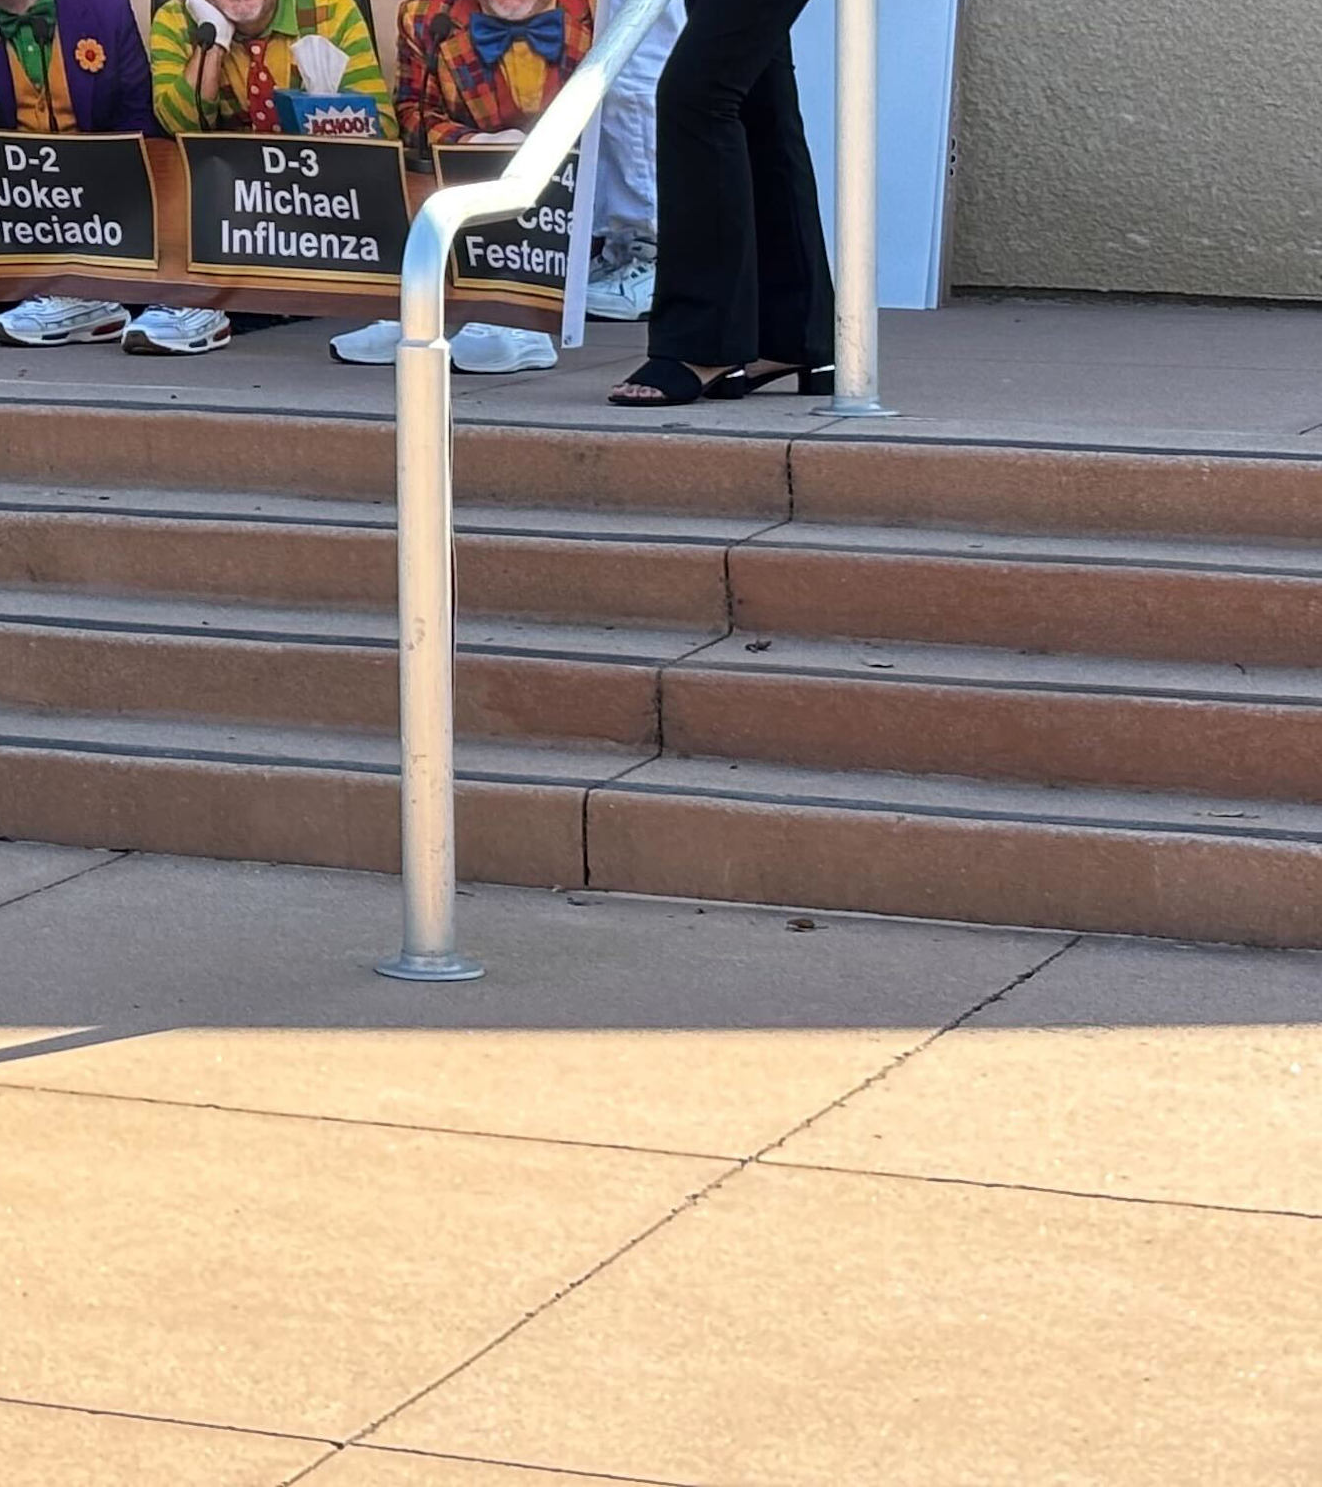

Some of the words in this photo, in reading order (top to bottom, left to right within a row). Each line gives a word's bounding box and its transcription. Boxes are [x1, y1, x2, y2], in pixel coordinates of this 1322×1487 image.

[4, 144, 61, 173] D-2
[261, 145, 320, 178] D-3
[551, 163, 575, 194] -4
[233, 179, 361, 221] Michael
[220, 219, 380, 263] Influenza
